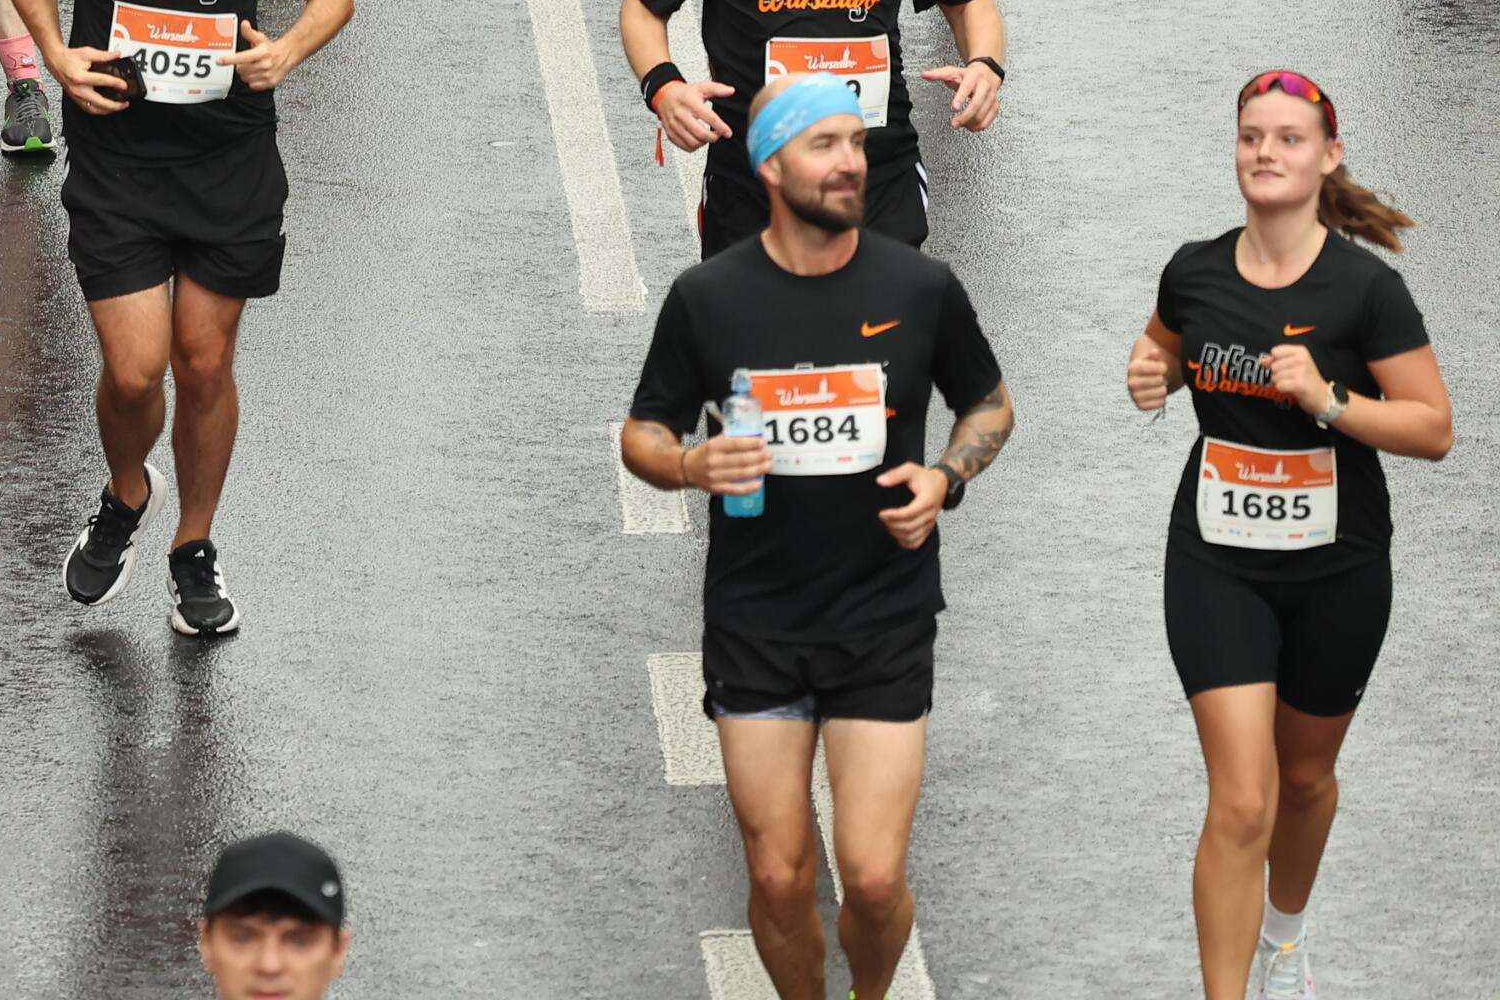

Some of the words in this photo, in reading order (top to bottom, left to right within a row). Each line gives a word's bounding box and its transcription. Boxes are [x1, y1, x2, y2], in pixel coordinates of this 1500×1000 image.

[133, 48, 211, 79] 4055
[765, 414, 860, 445] 1684
[1222, 489, 1311, 520] 1685
